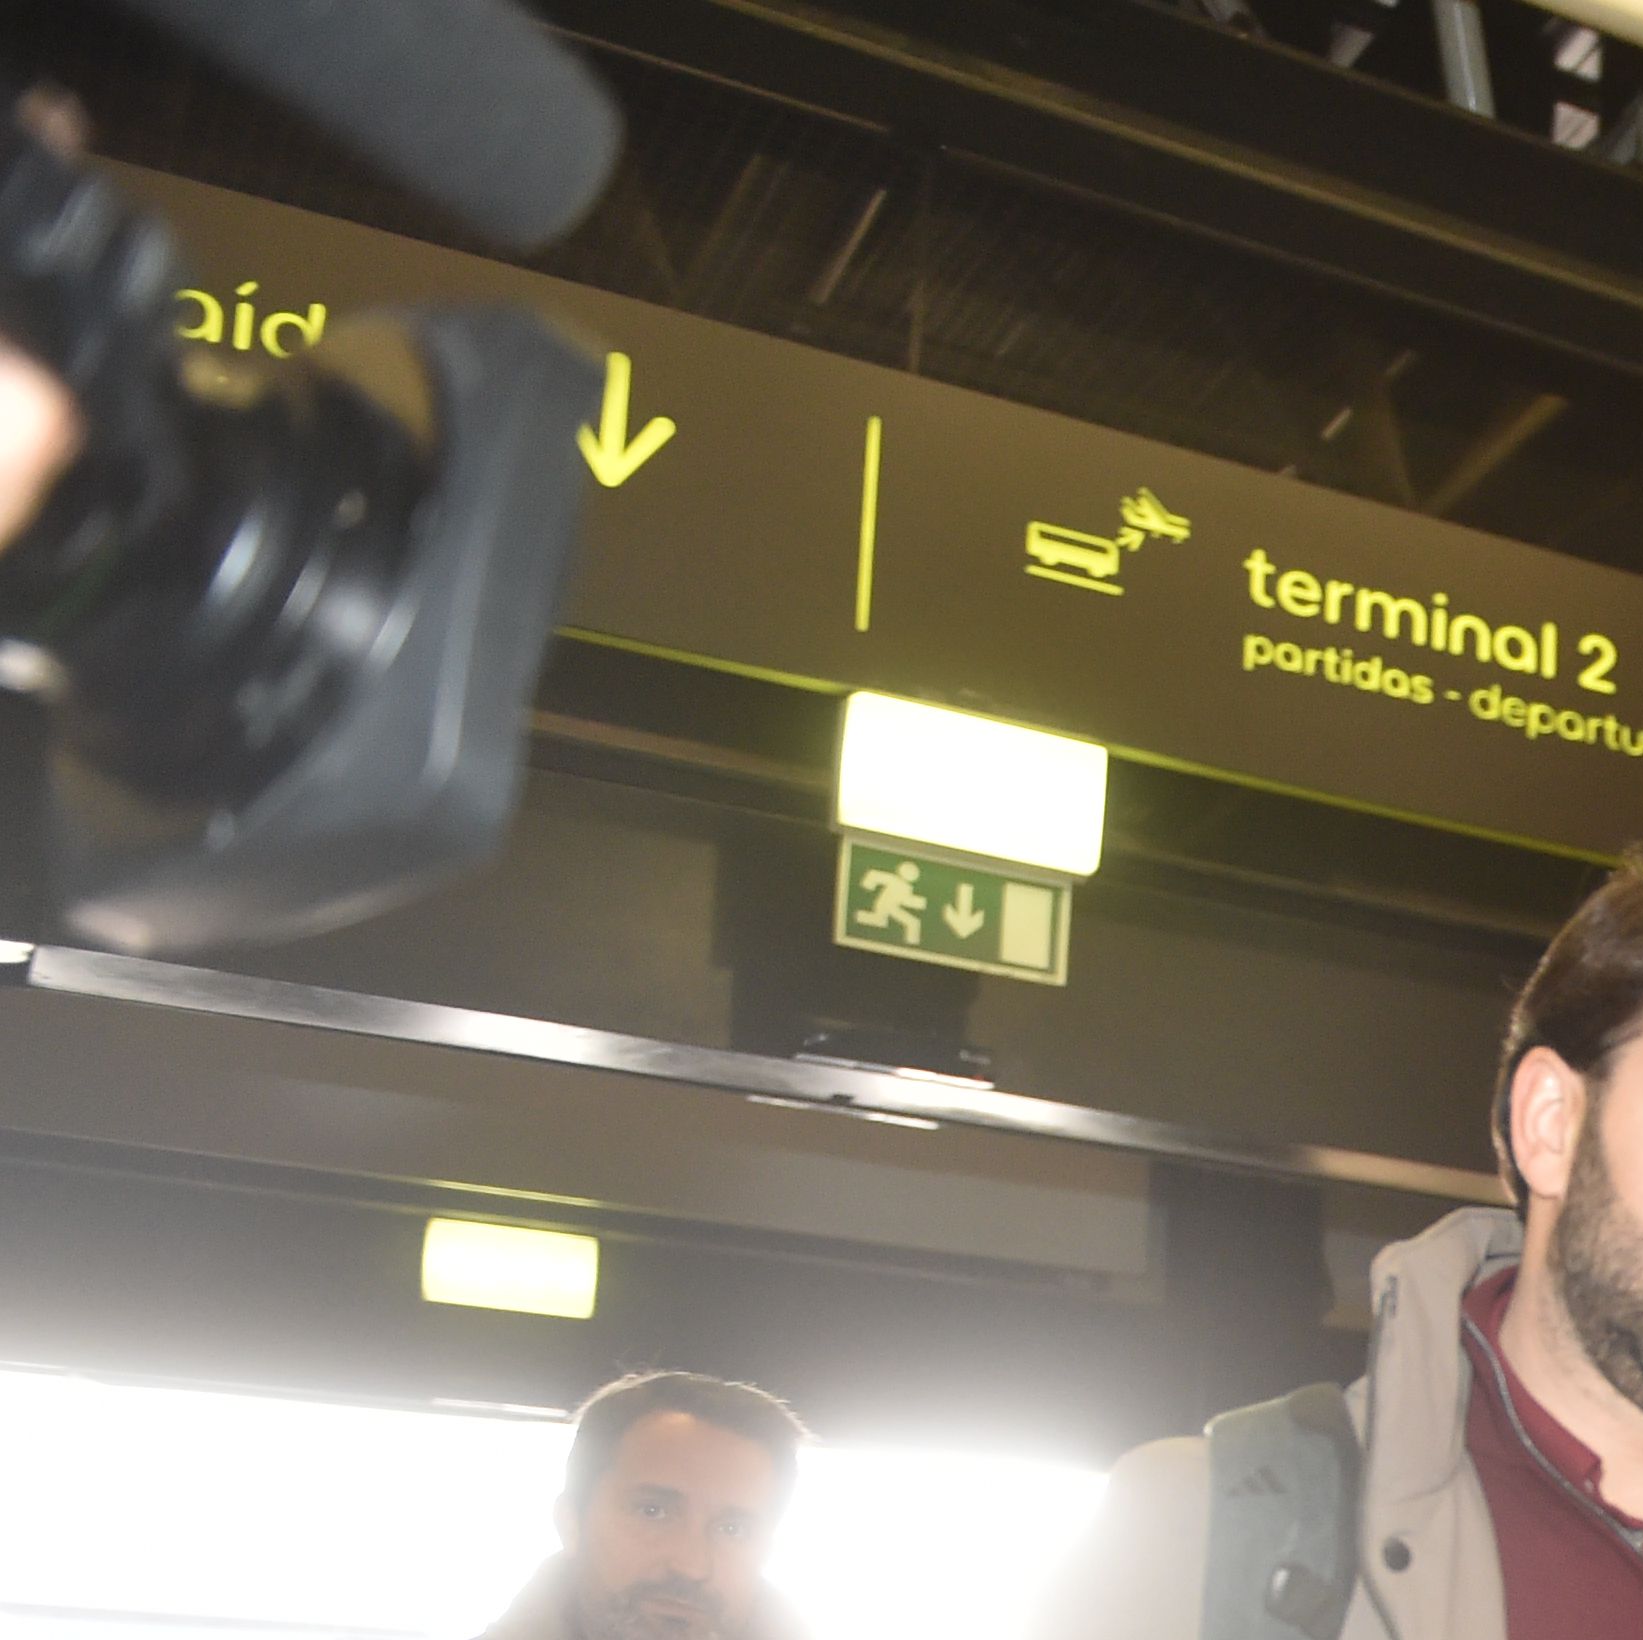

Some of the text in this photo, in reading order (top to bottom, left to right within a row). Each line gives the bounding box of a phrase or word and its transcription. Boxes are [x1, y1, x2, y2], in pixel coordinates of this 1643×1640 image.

[1242, 547, 1618, 695] terminal 2
[1242, 633, 1435, 705] partidas
